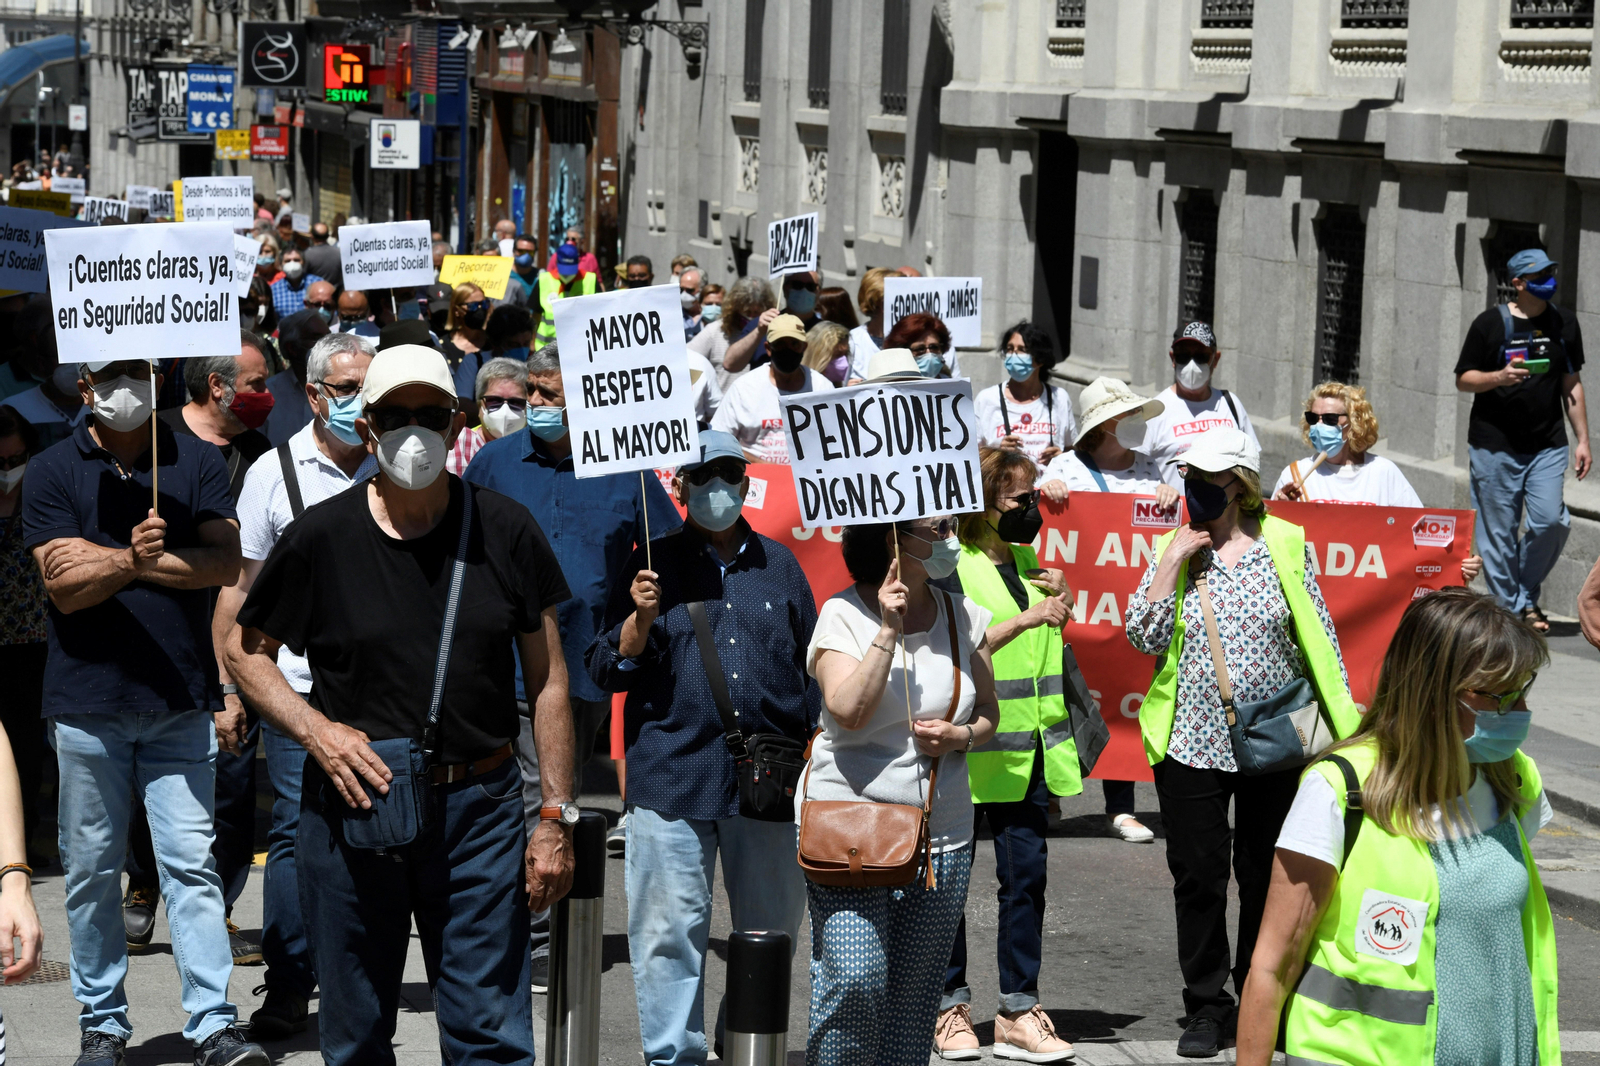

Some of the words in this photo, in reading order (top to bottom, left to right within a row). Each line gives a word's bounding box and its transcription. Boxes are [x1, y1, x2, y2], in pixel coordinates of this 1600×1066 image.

[190, 73, 232, 83] CHANGE
[185, 185, 203, 197] Desde
[205, 184, 232, 197] Podemos
[235, 187, 239, 197] a
[239, 184, 251, 197] Vox
[186, 204, 204, 221] exijo
[206, 204, 215, 217] mi
[217, 204, 252, 220] pensión.
[350, 238, 386, 256] ¡Cuentas
[389, 236, 416, 250] claras,
[418, 237, 430, 251] ya,
[771, 217, 814, 274] ¡BASTA!
[7, 250, 44, 271] Social!
[69, 253, 141, 291] ¡Cuentas
[147, 250, 203, 283] claras,
[209, 254, 233, 285] ya,
[345, 263, 355, 274] en
[358, 257, 398, 276] Seguridad
[401, 255, 429, 270] Social!
[453, 262, 497, 277] ¡Recortar
[58, 306, 77, 329] en
[84, 295, 165, 334] Seguridad
[171, 292, 229, 323] Social!
[946, 281, 977, 318] JAMÁS!
[586, 311, 664, 363] ¡MAYOR
[582, 365, 672, 408] RESPETO
[786, 389, 969, 461] PENSIONES
[582, 430, 609, 464] AL
[612, 418, 691, 460] MAYOR!
[799, 468, 905, 521] DIGNAS
[912, 460, 979, 516] ¡YA!
[1136, 503, 1178, 517] NO+
[1415, 565, 1442, 573] CCOO
